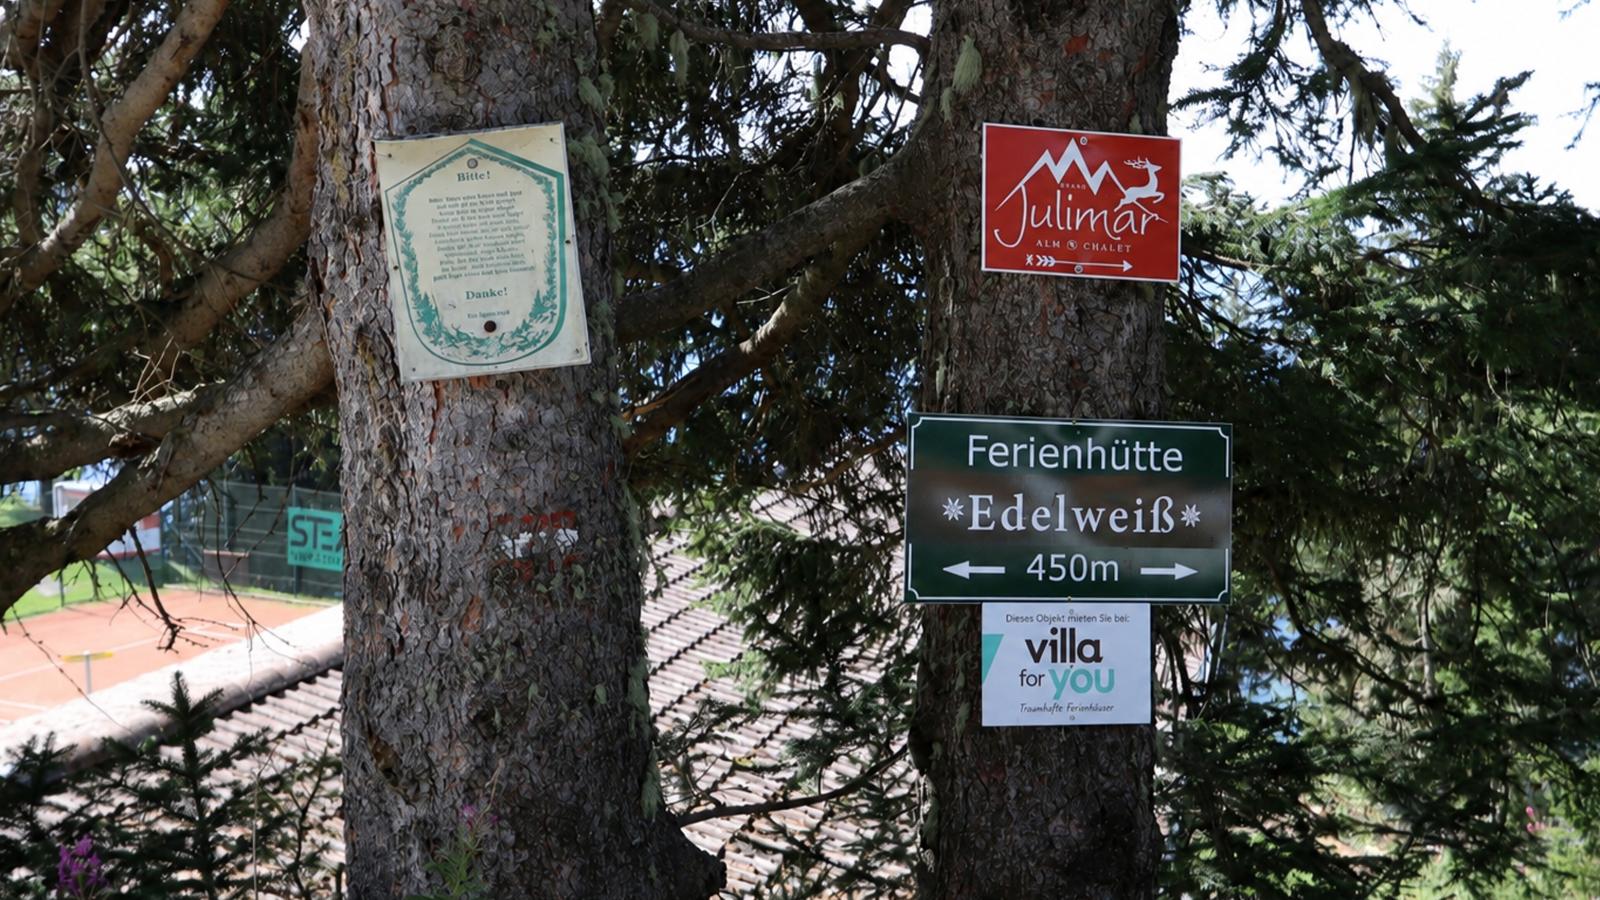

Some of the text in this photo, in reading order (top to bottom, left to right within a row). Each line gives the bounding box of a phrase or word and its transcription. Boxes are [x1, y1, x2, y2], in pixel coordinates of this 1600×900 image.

[457, 171, 491, 182] Bitte!
[993, 184, 1160, 248] Julimar
[1036, 240, 1132, 253] ALM CHALET
[465, 287, 508, 300] Danke!
[967, 434, 1183, 472] Ferienhütte
[967, 493, 1175, 534] Edelweiß
[1026, 554, 1119, 582] 450m
[1006, 614, 1130, 626] Dieses Objekt mieten Sie bei:
[1025, 627, 1104, 664] villa
[1019, 668, 1045, 687] for
[1020, 702, 1115, 715] Traumhafte Ferienhäuser
